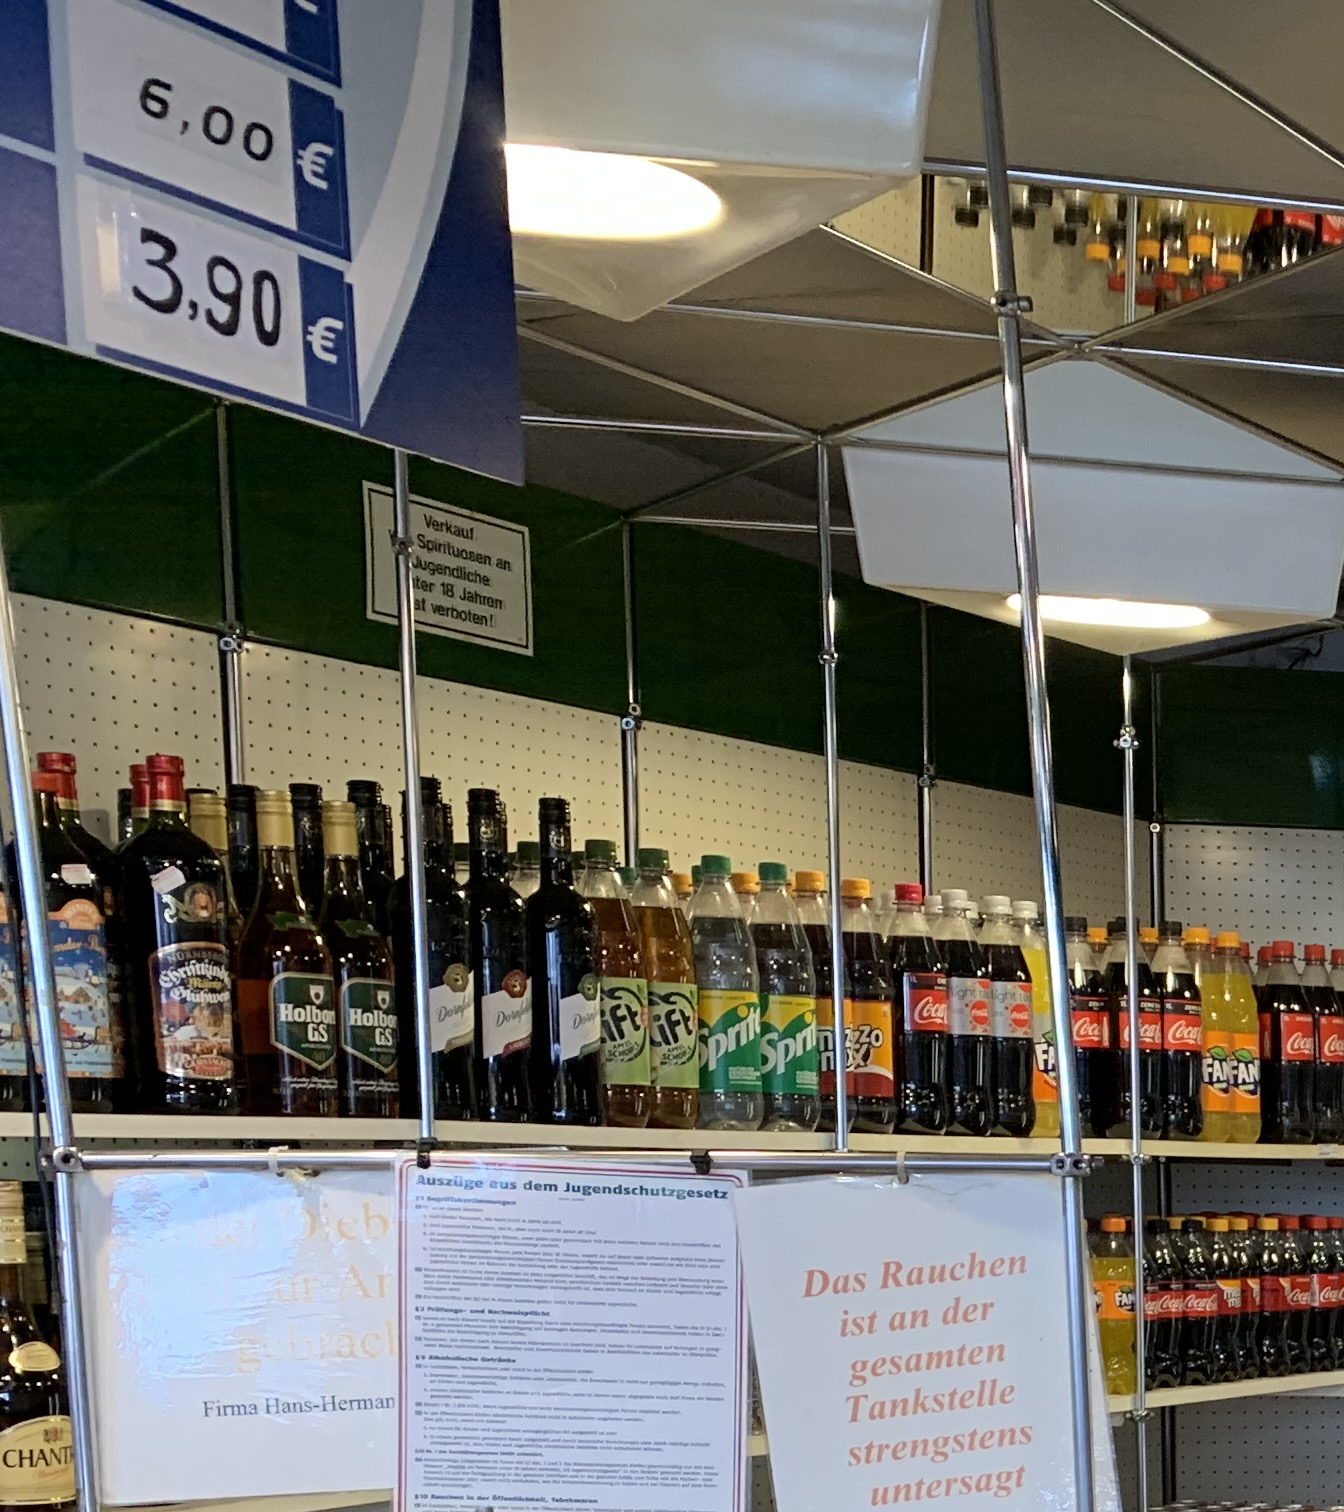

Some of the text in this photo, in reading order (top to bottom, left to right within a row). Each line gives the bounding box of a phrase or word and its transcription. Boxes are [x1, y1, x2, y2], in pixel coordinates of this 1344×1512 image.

[139, 77, 333, 191] 6,00 €
[132, 228, 344, 364] 3,90 €
[424, 514, 474, 541] Verkauf
[412, 555, 491, 586] Jugendliche
[417, 533, 492, 567] Spirituosen
[496, 557, 512, 572] an
[431, 601, 495, 628] verboten!
[440, 582, 503, 610] 18 Jahren
[307, 1023, 329, 1043] GS
[374, 1028, 393, 1046] GS
[416, 1174, 729, 1201] Auszüge aus dem Jugendschutzgesetz
[802, 1251, 1028, 1298] Das Rauchen
[839, 1296, 995, 1338] ist an der
[848, 1343, 1006, 1388] gesamten
[203, 1394, 395, 1418] Firma Hans-Herman
[845, 1378, 1016, 1424] Tankstelle
[847, 1425, 1033, 1467] strengstens
[870, 1464, 1026, 1507] untersagt
